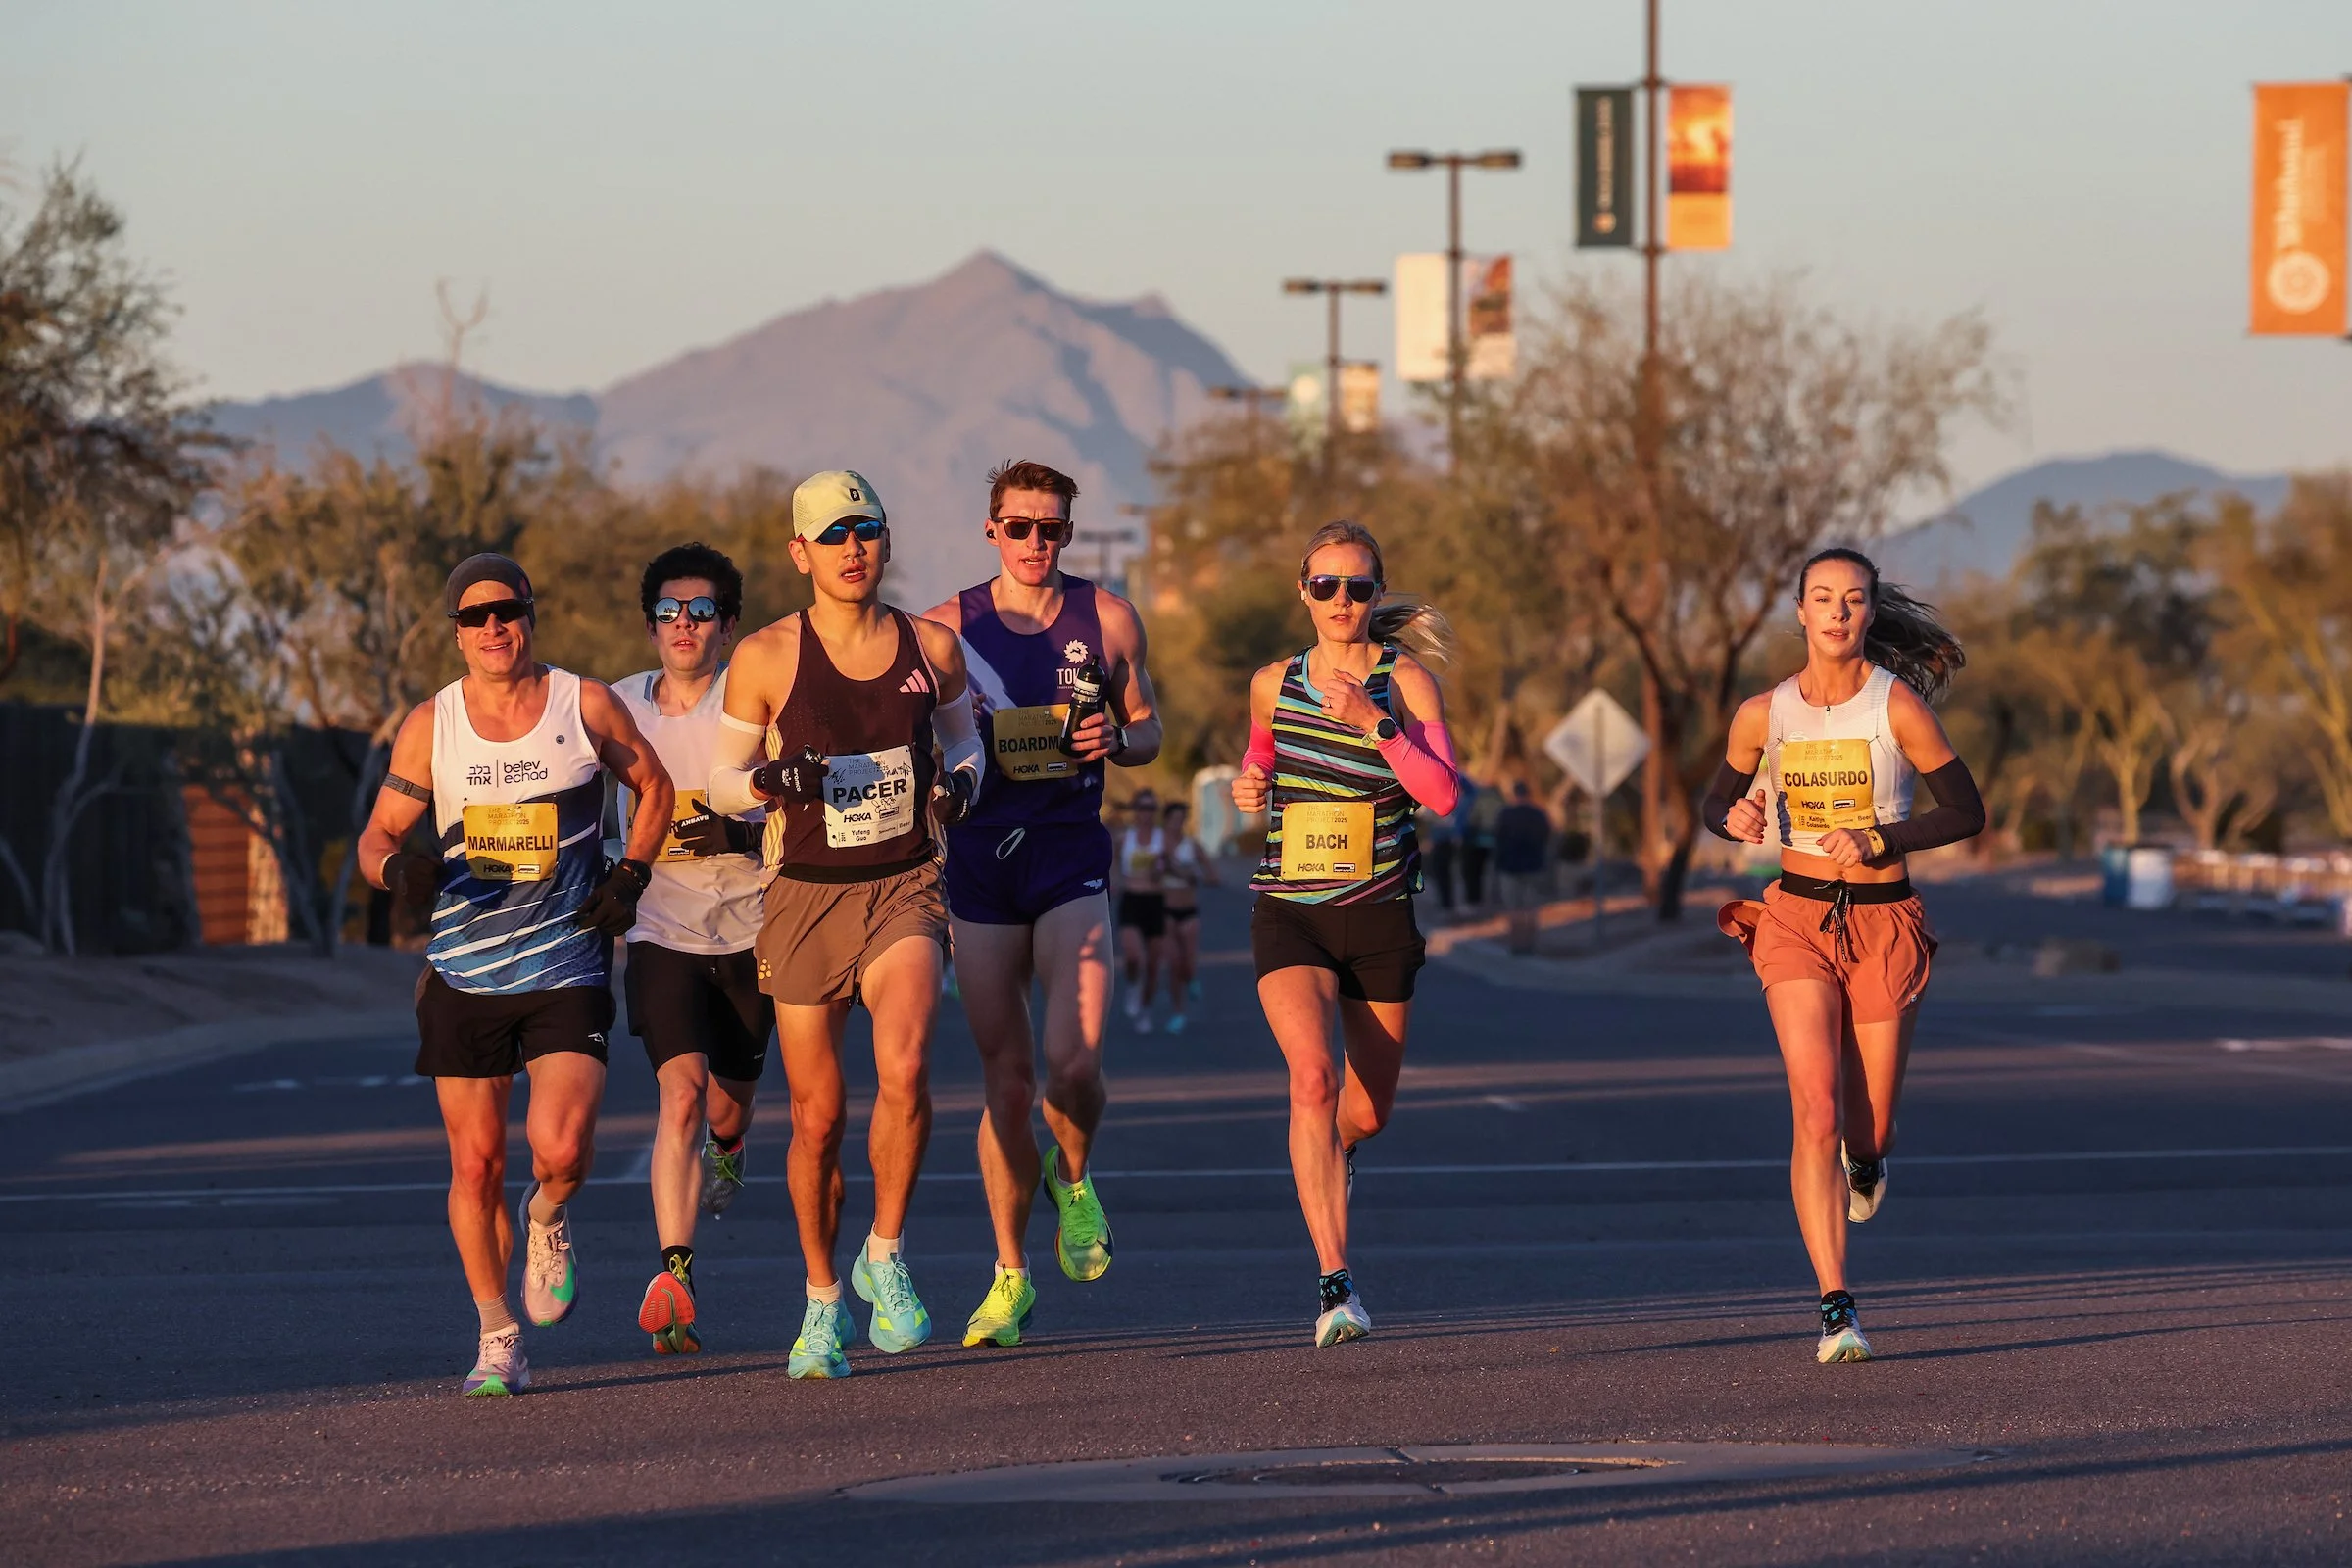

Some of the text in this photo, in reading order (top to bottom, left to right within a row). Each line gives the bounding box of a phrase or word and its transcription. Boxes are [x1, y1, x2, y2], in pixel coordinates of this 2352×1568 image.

[998, 735, 1059, 753] BOARDM
[469, 764, 491, 775] בלב
[1013, 764, 1040, 774] HOKA
[466, 775, 492, 786] אחד
[504, 768, 548, 784] echad
[1785, 770, 1868, 787] COLASURDO
[832, 778, 907, 804] PACER
[1801, 800, 1826, 809] HOKA
[844, 812, 872, 823] HOKA
[467, 835, 553, 851] MARMARELLI
[1306, 834, 1348, 849] BACH
[483, 864, 512, 873] HOKA
[1298, 863, 1326, 872] HOKA
